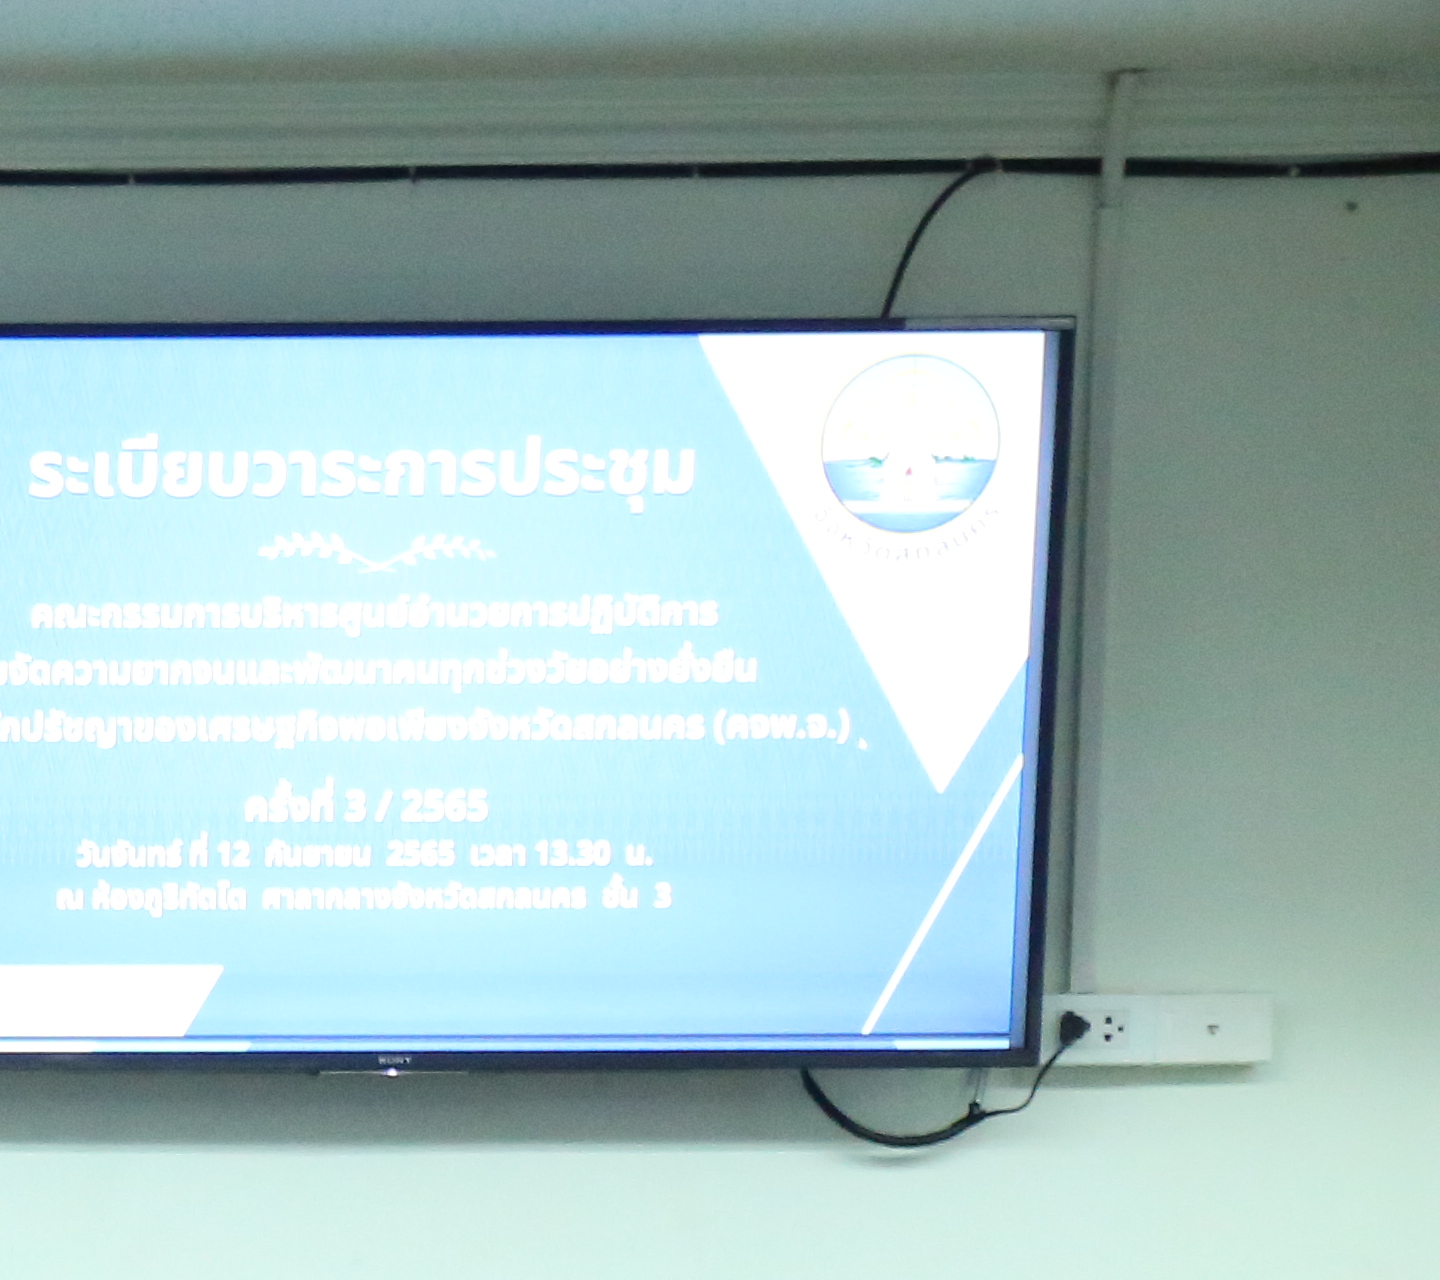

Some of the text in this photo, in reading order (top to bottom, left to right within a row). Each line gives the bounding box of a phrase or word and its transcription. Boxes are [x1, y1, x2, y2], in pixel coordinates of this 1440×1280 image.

[26, 432, 698, 515] ระเบียบวาระการประชุม
[30, 592, 720, 639] คณะกรรมการบริหารศูนย์อำนวยการปฏิบัติการ
[243, 776, 489, 823] ครั้งที่ 3 / 2565
[76, 830, 654, 868] วันจันทร์ ที่ 12 กันยายน 2565 เวลา 13.30 น.
[55, 887, 85, 912] ณ
[261, 882, 588, 912] ศาลากลางจังหวัดสกลนคร
[601, 876, 639, 912] ชั้น
[652, 884, 673, 911] 3
